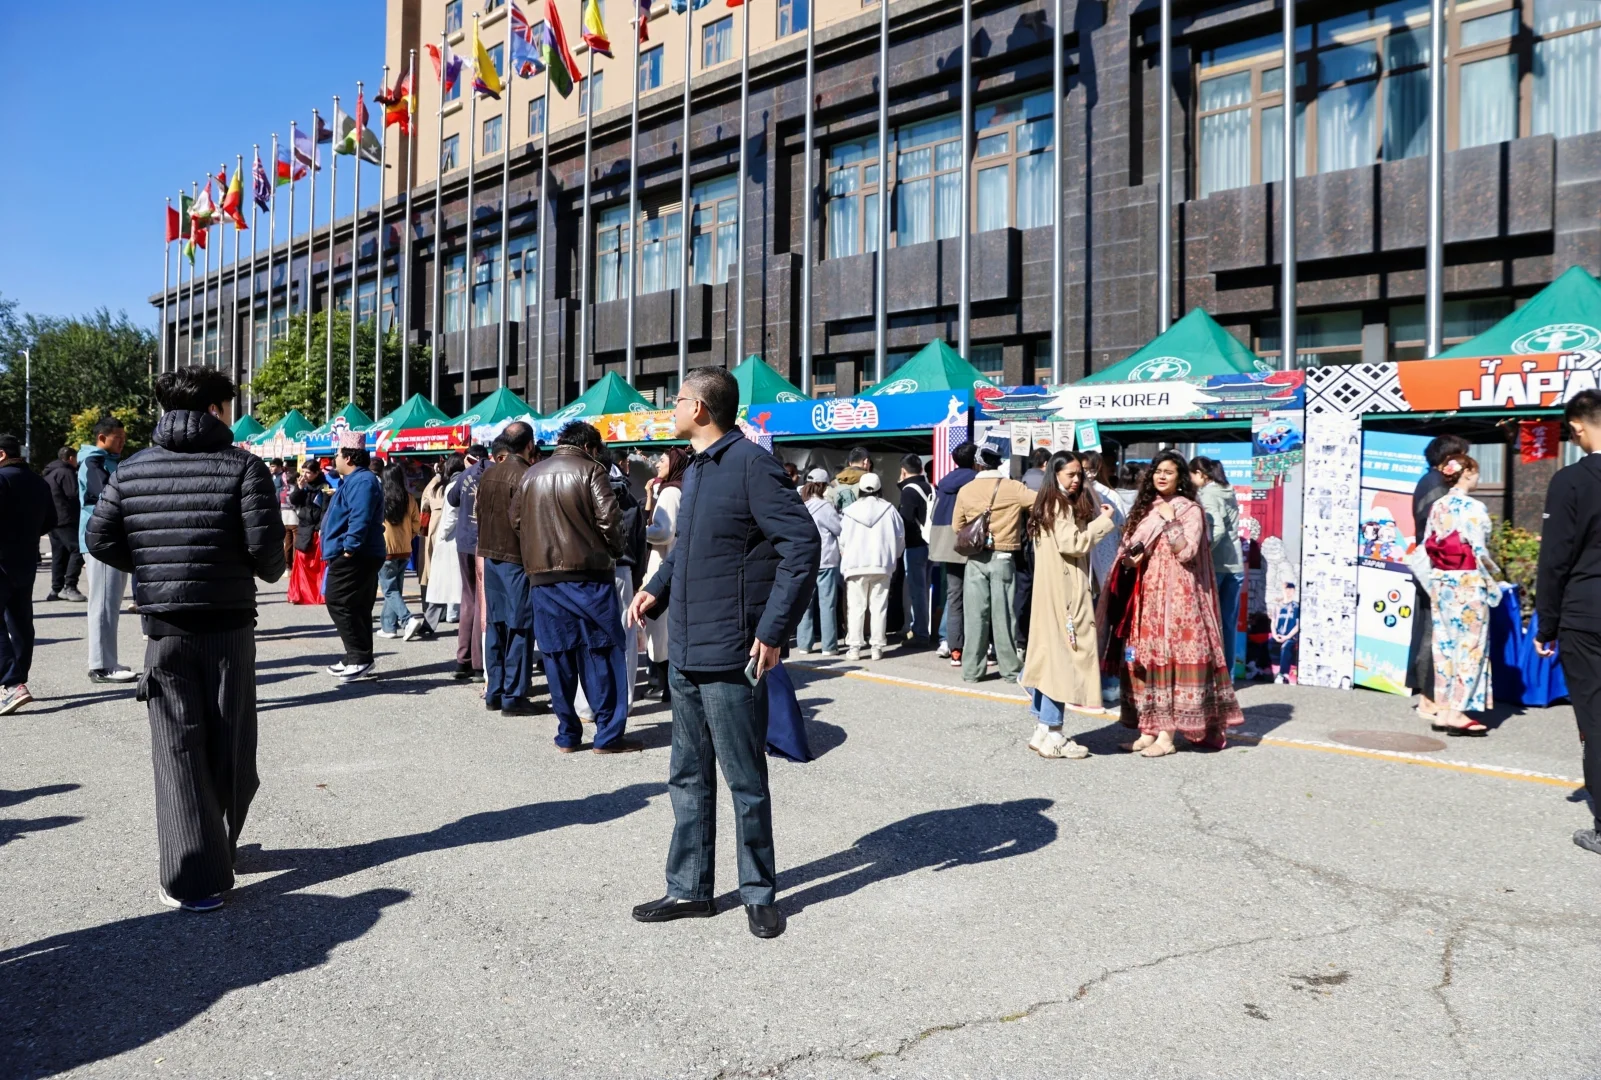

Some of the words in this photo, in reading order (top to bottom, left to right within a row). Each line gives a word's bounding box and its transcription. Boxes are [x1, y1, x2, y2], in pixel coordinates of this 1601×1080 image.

[1459, 369, 1601, 408] JAPA
[824, 397, 856, 407] Welcome
[1079, 395, 1106, 409] 한국
[1111, 392, 1169, 407] KOREA
[811, 401, 879, 432] USA
[1361, 558, 1386, 569] JAPAN
[1375, 600, 1384, 613] J
[1400, 606, 1410, 618] N
[1386, 615, 1396, 626] P
